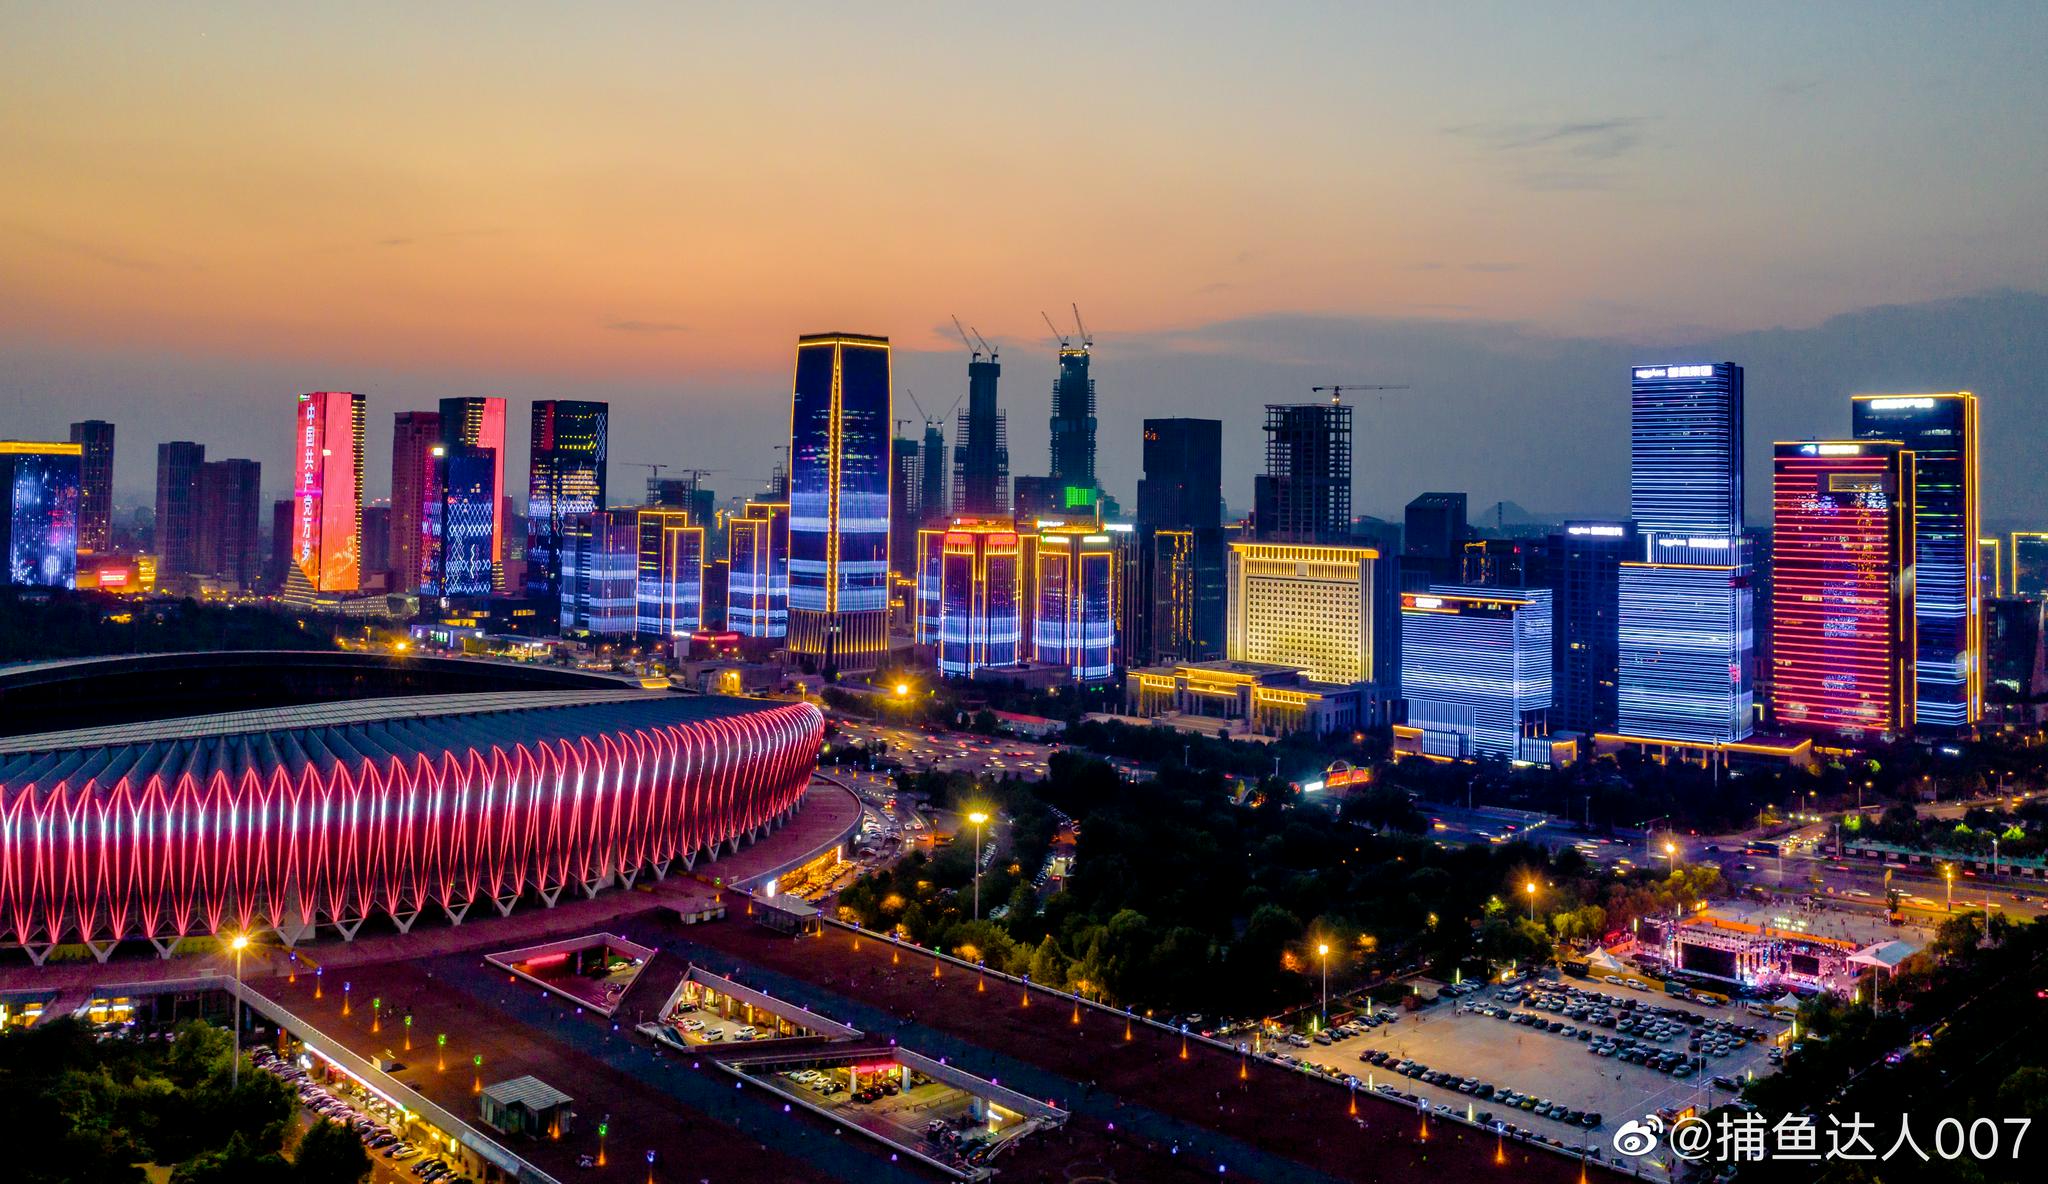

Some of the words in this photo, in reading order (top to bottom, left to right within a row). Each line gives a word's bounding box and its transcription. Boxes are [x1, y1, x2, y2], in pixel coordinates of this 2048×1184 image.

[302, 404, 315, 561] 中国共产党万岁
